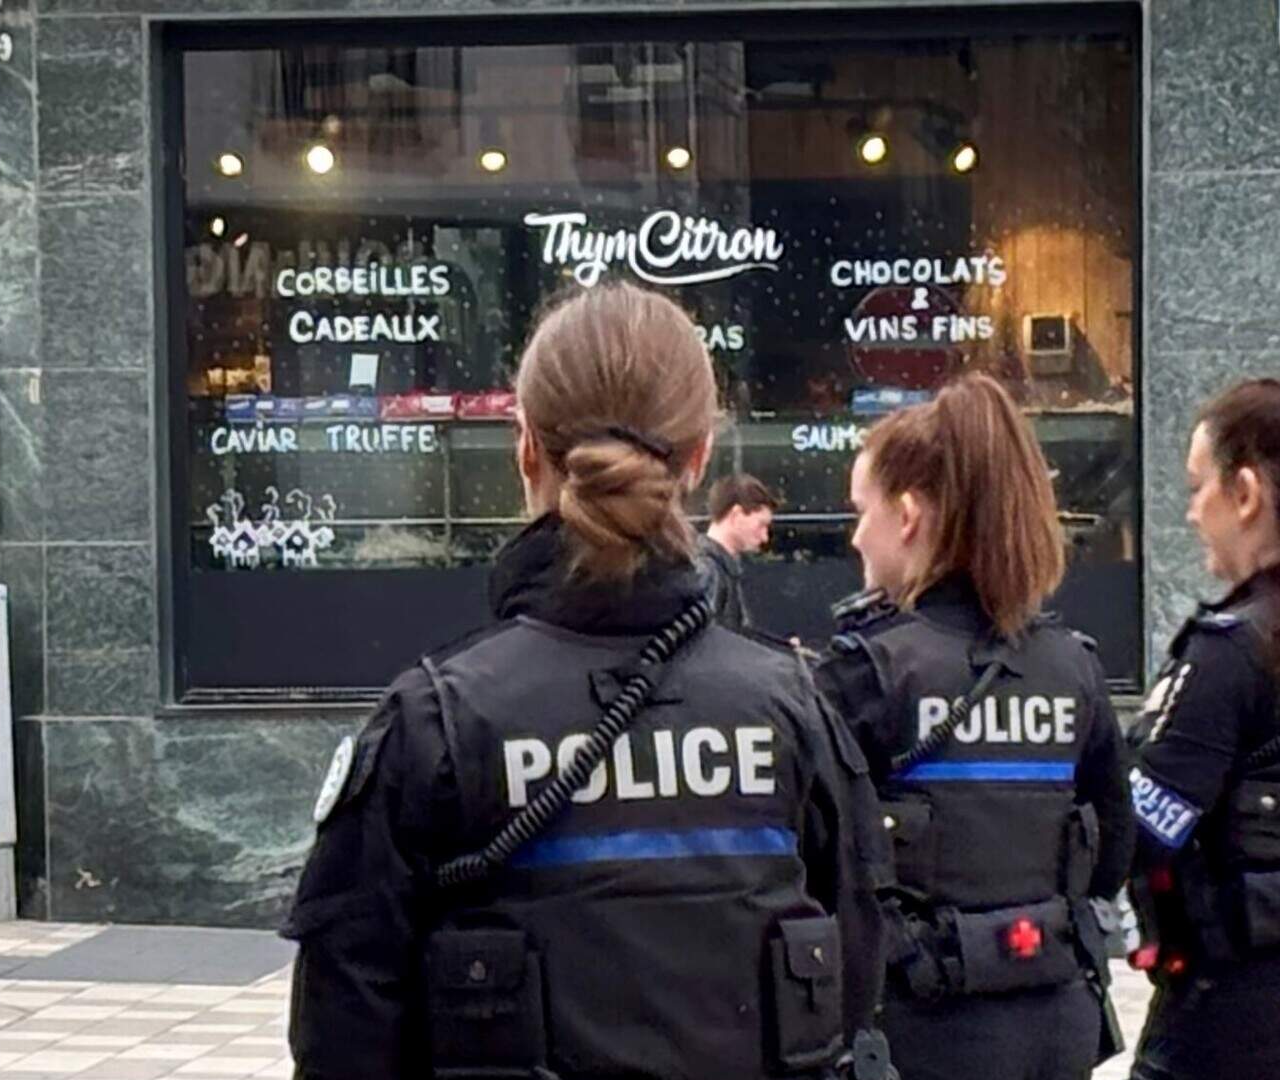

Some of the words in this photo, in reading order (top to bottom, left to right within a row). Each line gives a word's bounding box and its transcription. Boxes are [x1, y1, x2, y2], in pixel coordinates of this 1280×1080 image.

[830, 256, 1007, 287] CHOCOLATS
[910, 287, 930, 310] &
[288, 310, 440, 343] CADEAUX
[694, 324, 745, 351] RAS
[844, 315, 918, 342] VINS
[932, 314, 995, 342] FINS
[210, 421, 300, 455] CAVIAR
[327, 423, 438, 454] TRUFFE
[917, 695, 1077, 744] POLICE
[503, 725, 777, 808] POLICE
